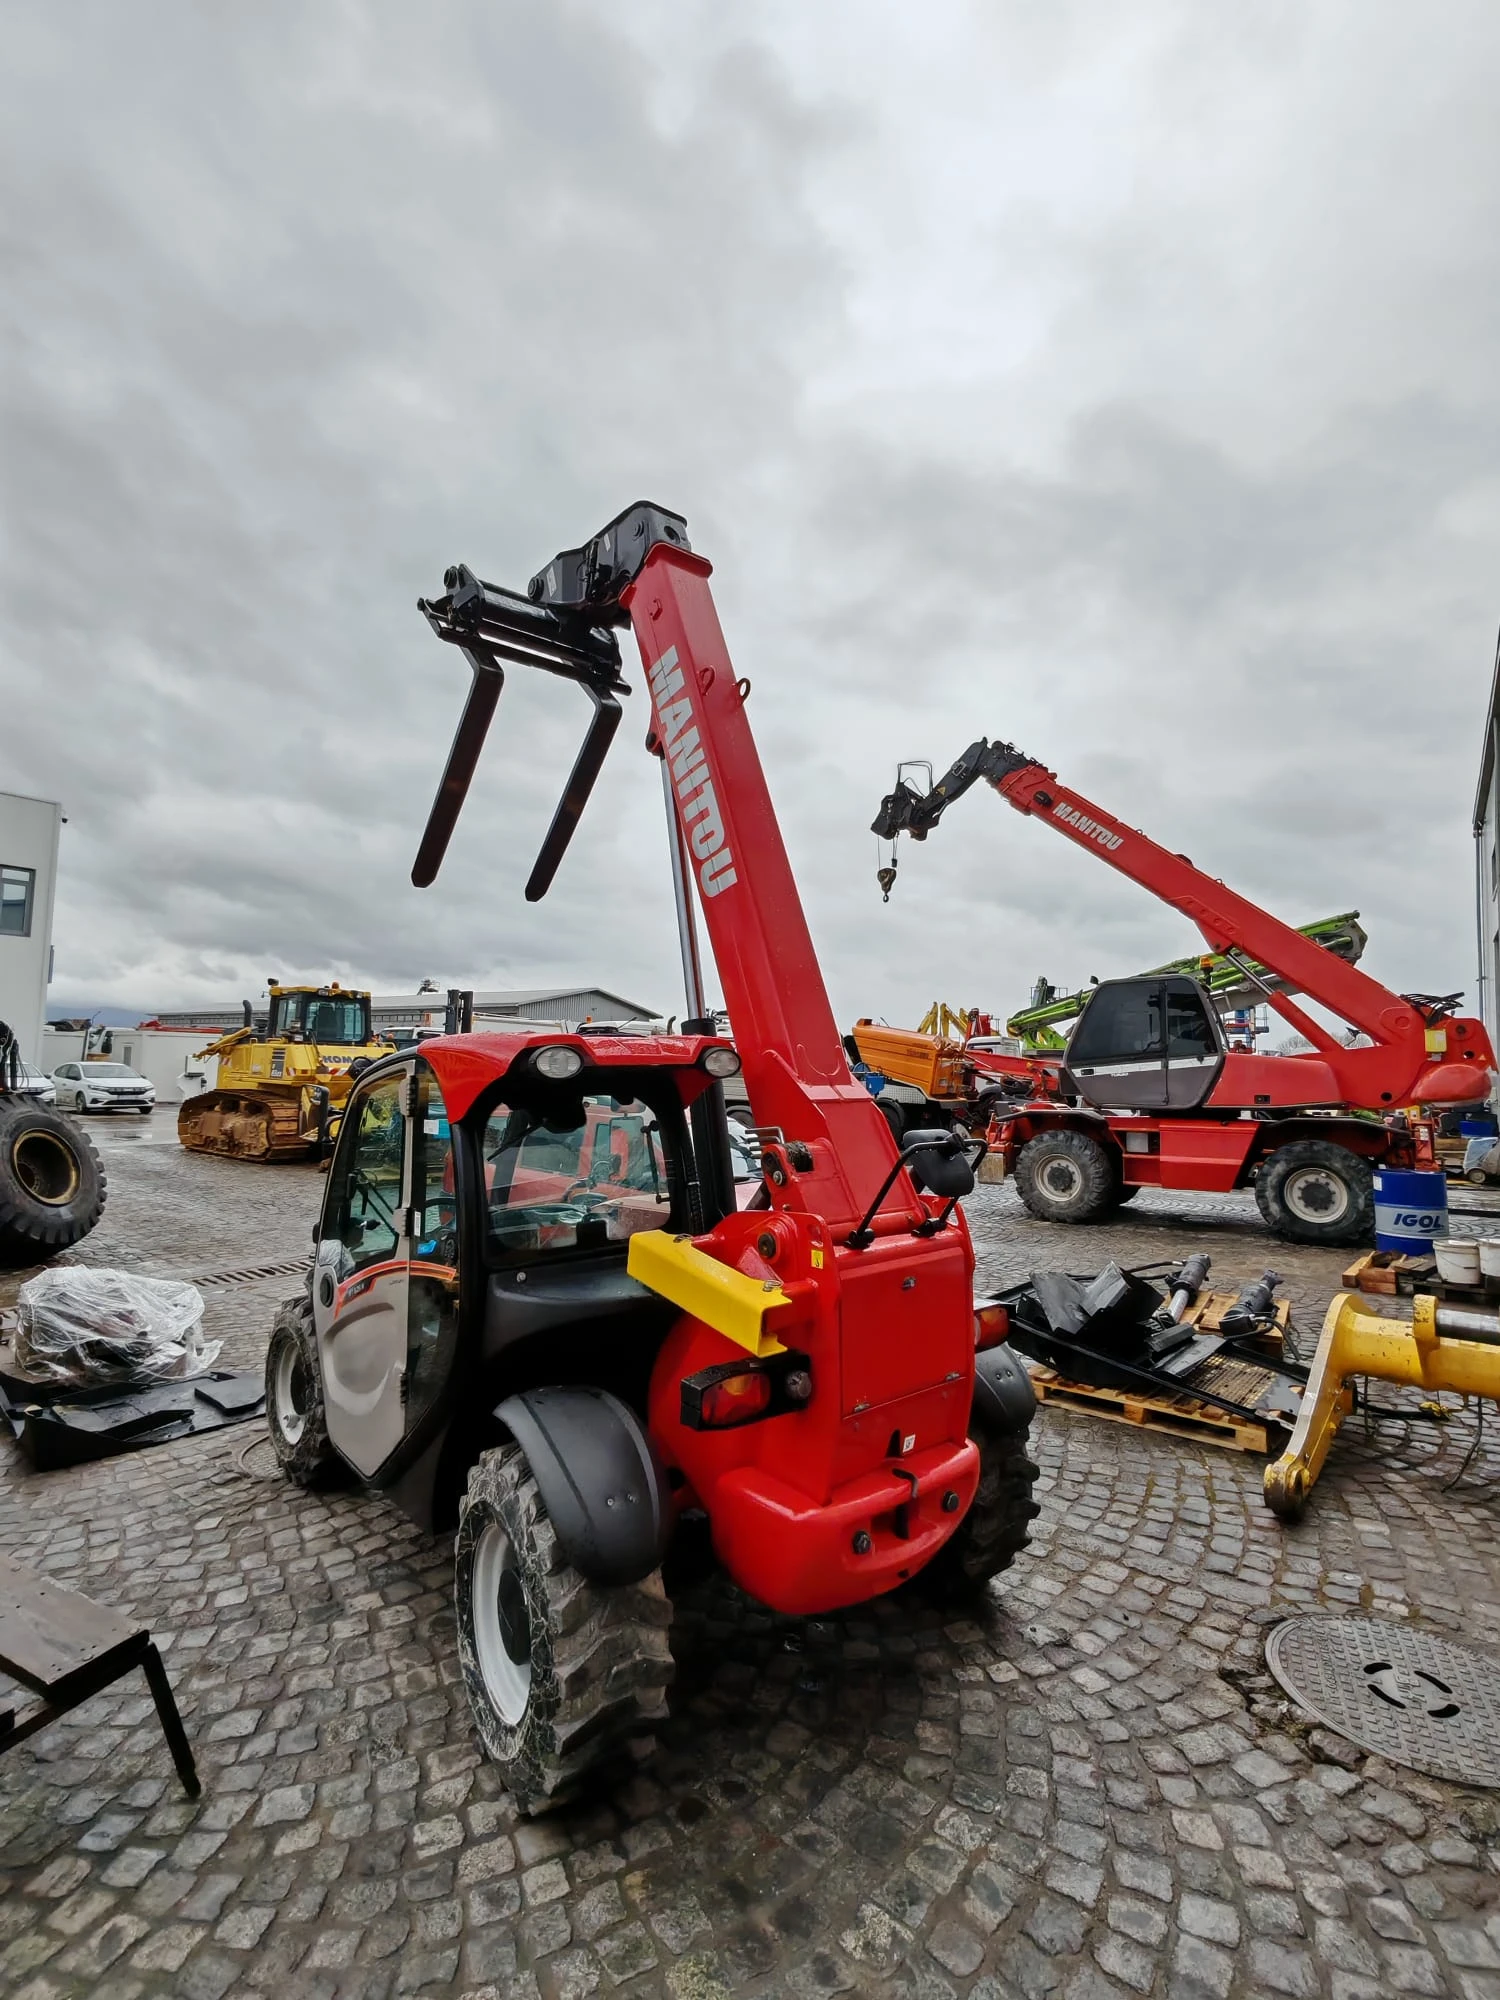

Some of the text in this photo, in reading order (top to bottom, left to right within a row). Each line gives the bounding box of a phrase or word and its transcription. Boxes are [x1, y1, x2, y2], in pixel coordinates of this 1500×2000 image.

[649, 645, 738, 898] MANITOU
[1052, 802, 1124, 850] MANITOU
[322, 1055, 353, 1064] KOM
[1393, 1213, 1444, 1229] IGOL
